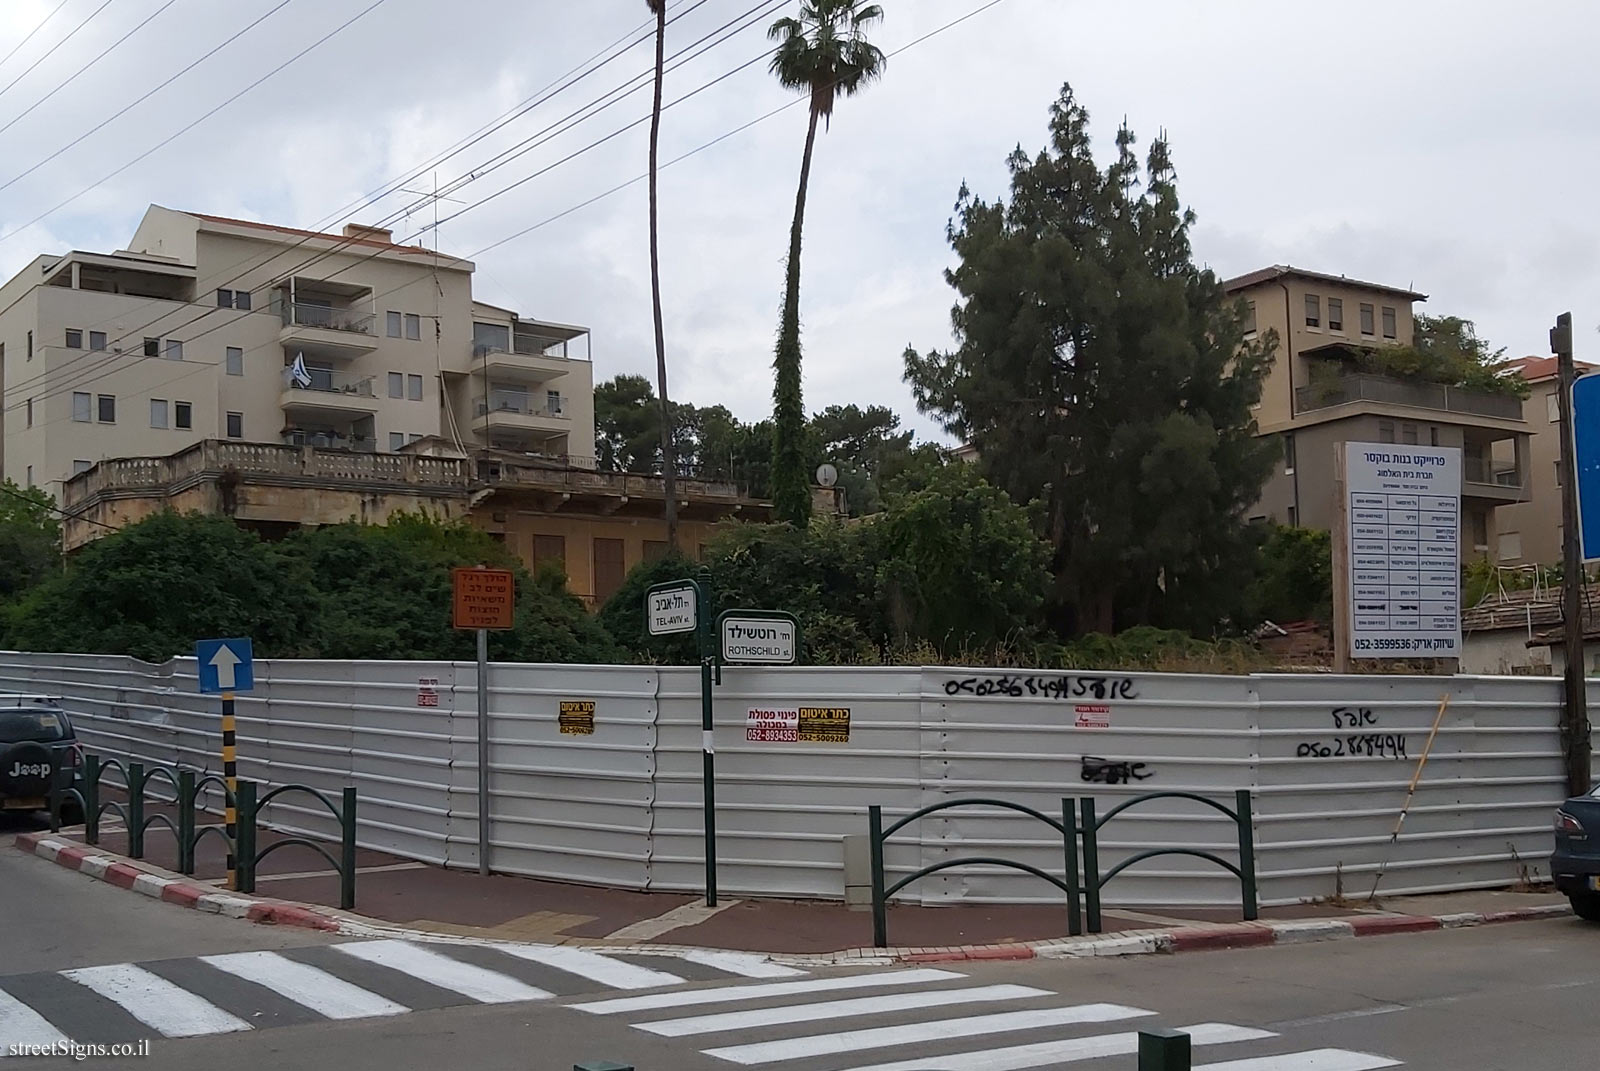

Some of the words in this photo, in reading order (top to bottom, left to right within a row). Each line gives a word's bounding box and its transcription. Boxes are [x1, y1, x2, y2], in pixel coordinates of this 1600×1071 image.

[1364, 453, 1391, 464] בוקסר
[1393, 454, 1411, 464] בנות
[1413, 456, 1445, 467] פרוייקט
[469, 584, 482, 592] לב
[484, 585, 506, 593] שים
[463, 594, 505, 603] משאיות
[655, 593, 684, 612] תל-אביב
[655, 615, 683, 626] TEL-AVIV
[728, 624, 777, 640] רוטשילד
[728, 645, 780, 656] ROTHSCHILD
[748, 708, 776, 720] פסולת
[778, 710, 797, 720] פינוי
[801, 708, 828, 719] איטום
[830, 709, 849, 719] כתר
[747, 729, 797, 741] 052-8934353
